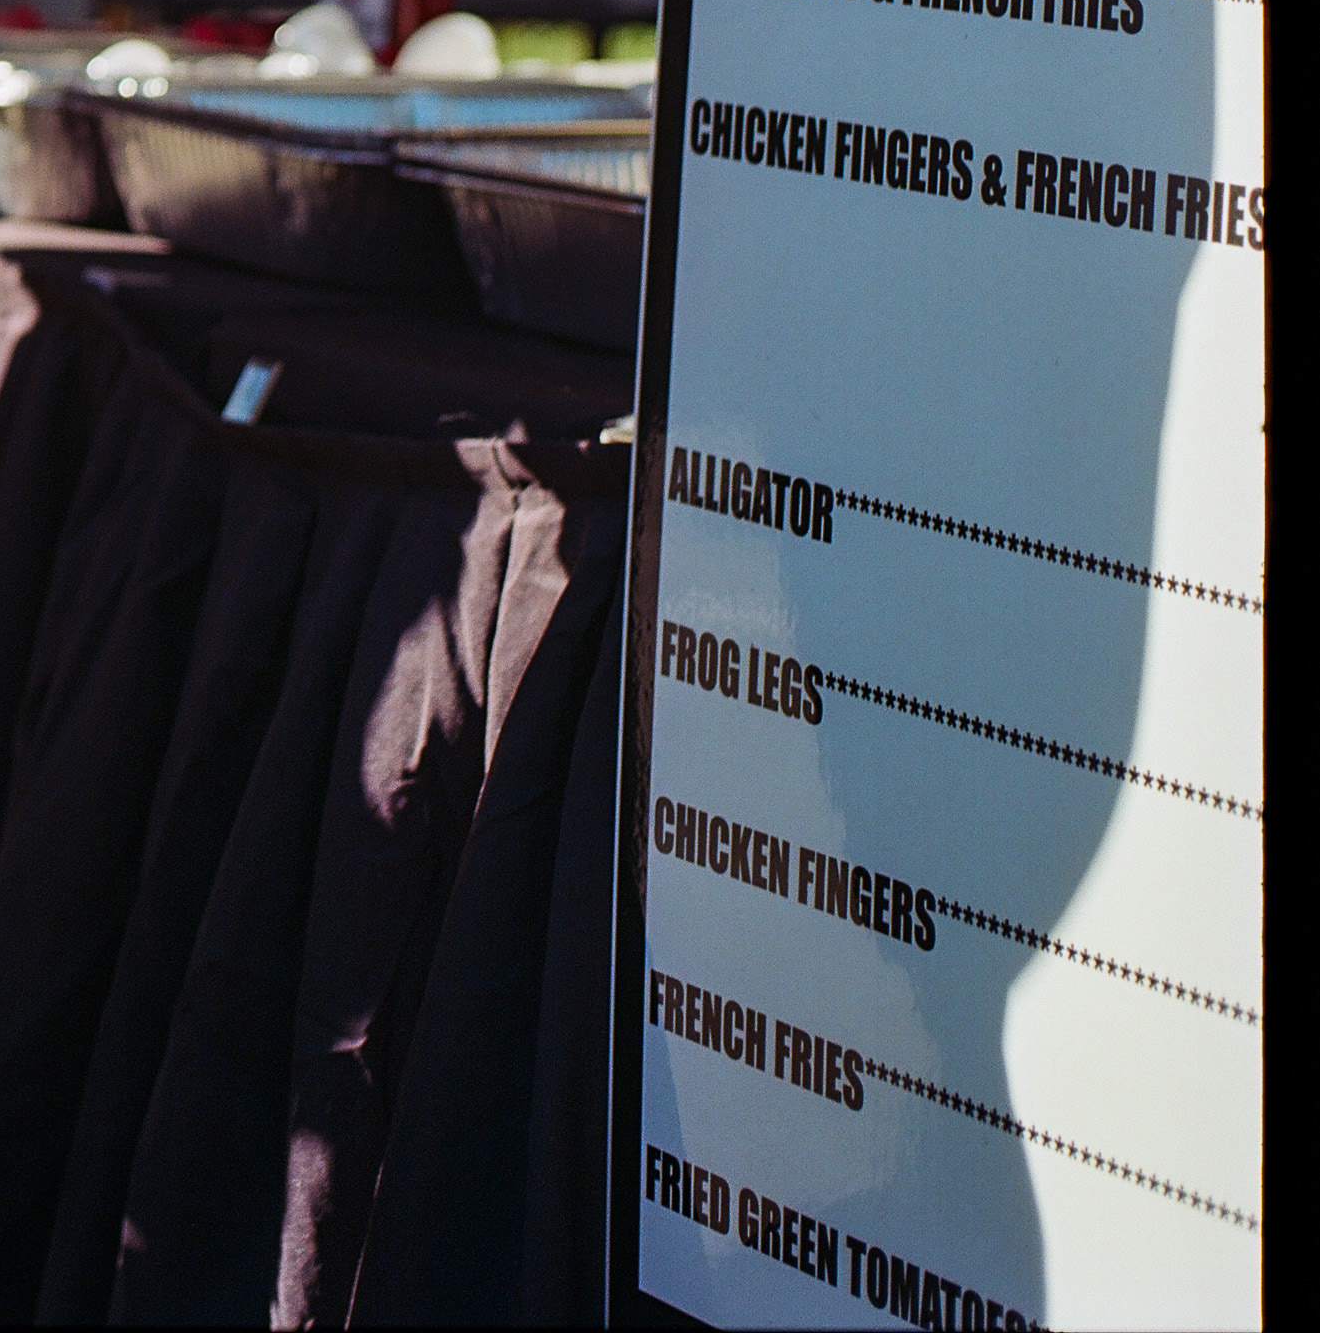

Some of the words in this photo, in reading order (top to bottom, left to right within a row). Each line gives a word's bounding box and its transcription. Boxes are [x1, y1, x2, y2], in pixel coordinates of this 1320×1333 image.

[689, 98, 828, 176] CHICKEN
[834, 121, 974, 201] FINGERS
[981, 155, 1008, 206] &
[1015, 150, 1157, 232] FRENCH
[668, 446, 834, 544] ALLIGATOR
[660, 621, 741, 699] FROG
[747, 643, 825, 725] LEGS
[653, 795, 791, 897] CHICKEN
[798, 842, 937, 952] FINGERS
[650, 969, 767, 1071] FRENCH
[773, 1019, 865, 1112] FRIES
[645, 1144, 730, 1237] FRIED
[738, 1188, 839, 1287] GREEN
